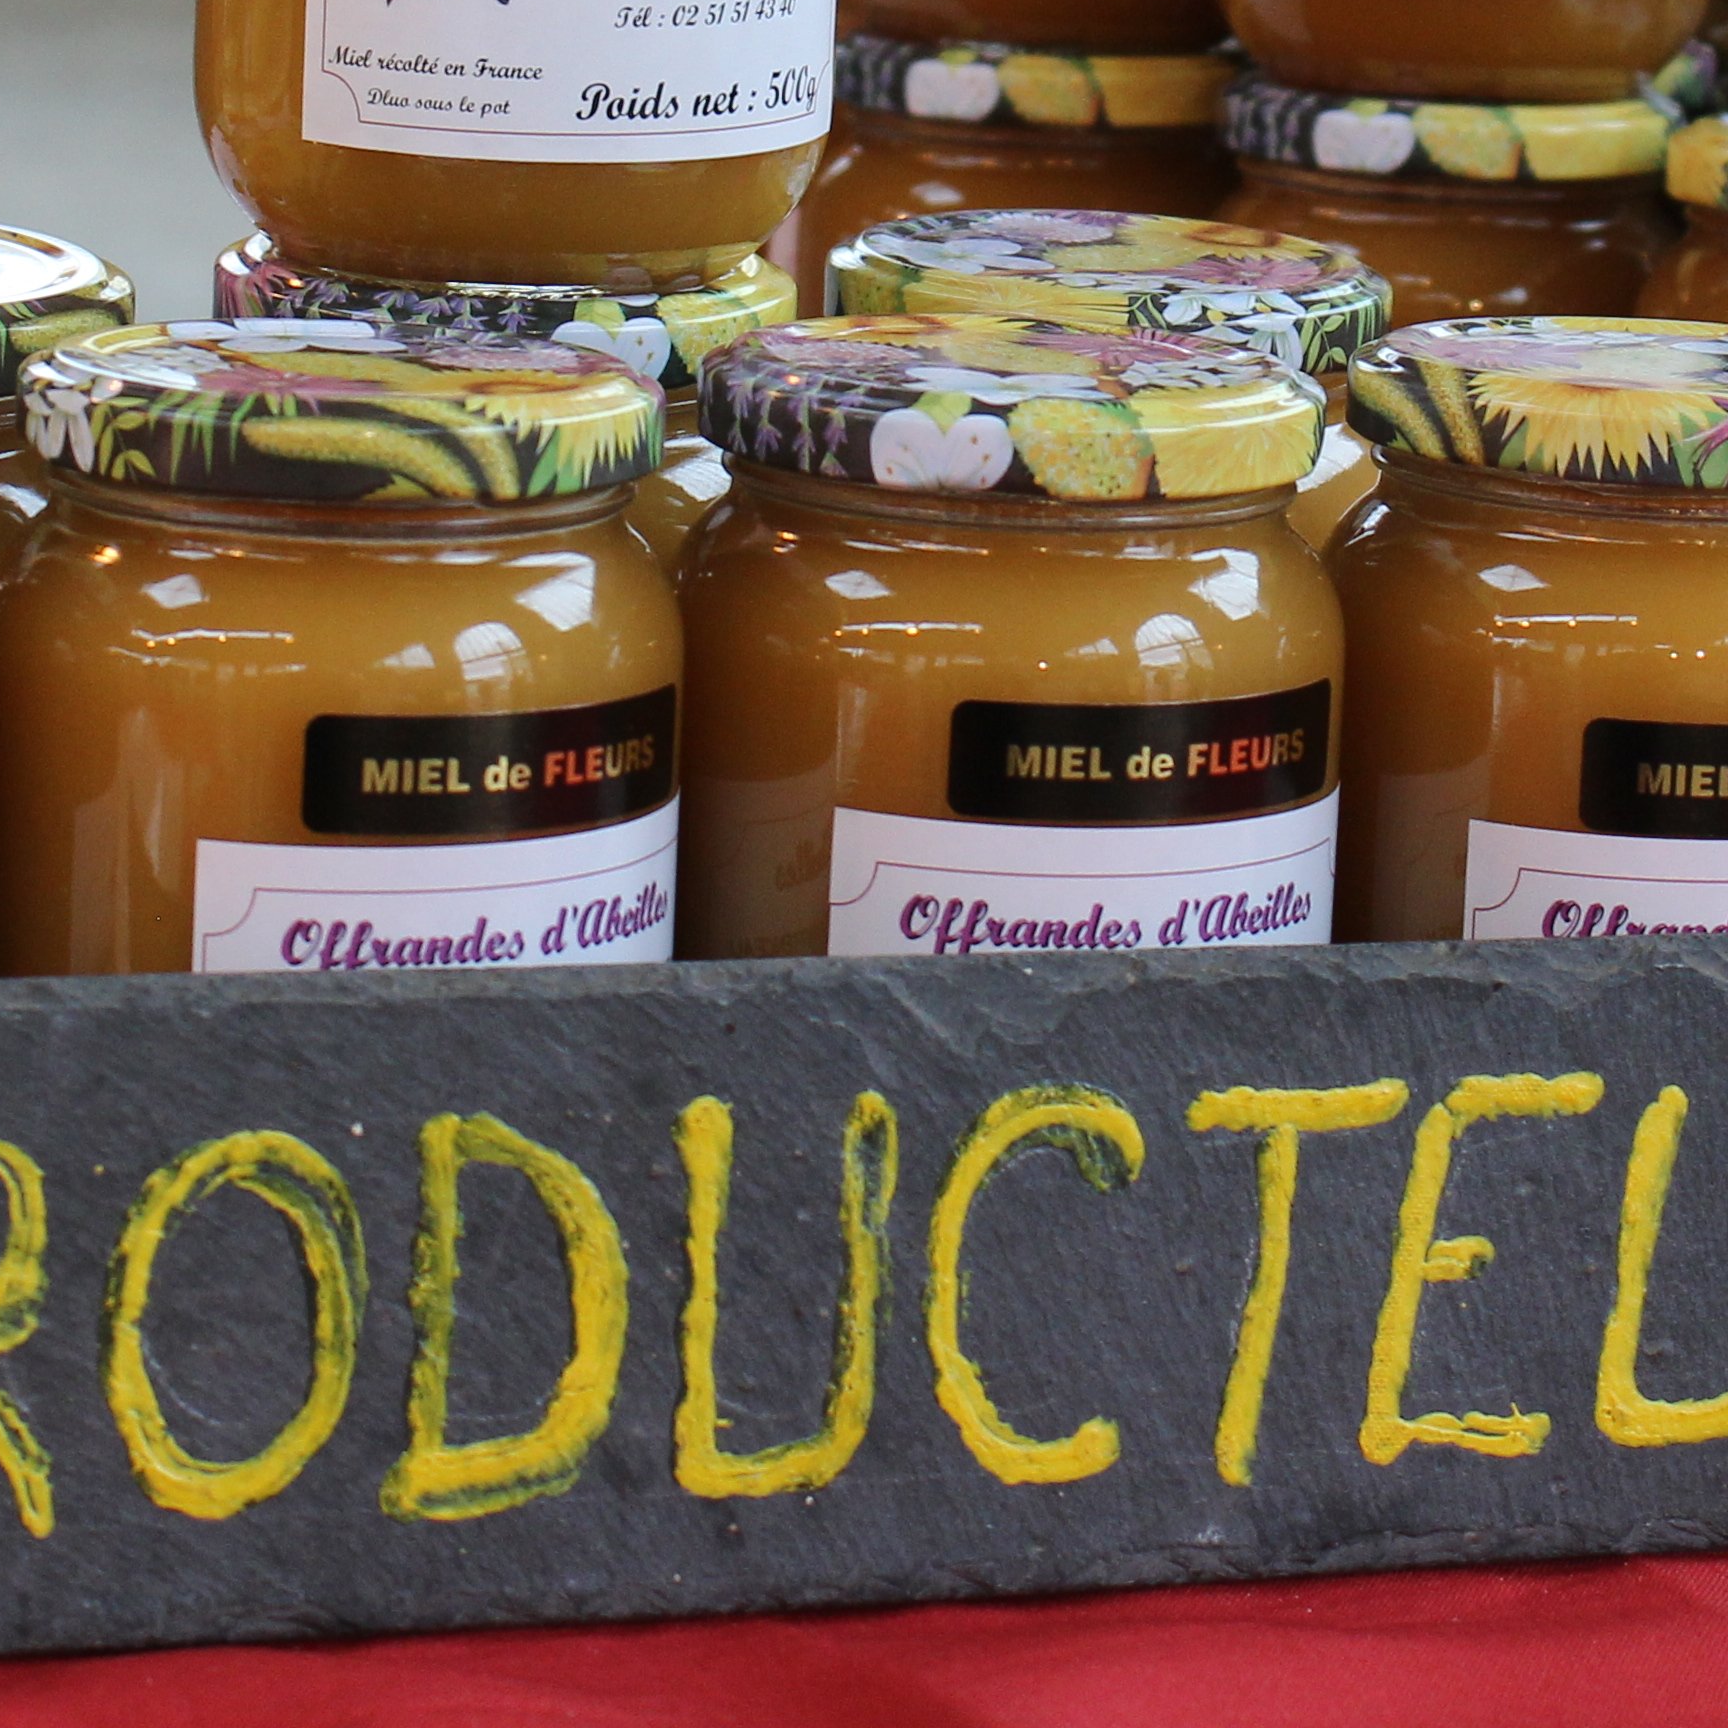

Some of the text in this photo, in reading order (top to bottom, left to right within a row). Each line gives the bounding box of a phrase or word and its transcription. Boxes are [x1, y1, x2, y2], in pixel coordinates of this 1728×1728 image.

[613, 5, 652, 29] Tél
[672, 4, 700, 28] 02
[704, 2, 726, 27] 51
[730, 0, 751, 24] 51
[327, 45, 545, 82] Miel récolté en France
[366, 87, 512, 120] Dluo sous le pot
[576, 80, 680, 122] Poids
[691, 81, 742, 119] net
[765, 64, 818, 114] 500g
[360, 734, 656, 796] MIEL de FLEURS
[1005, 728, 1306, 782] MIEL de FLEURS
[280, 880, 669, 972] Offrandes d'Abeilles
[899, 880, 1312, 956] Offrandes d'Abeilles
